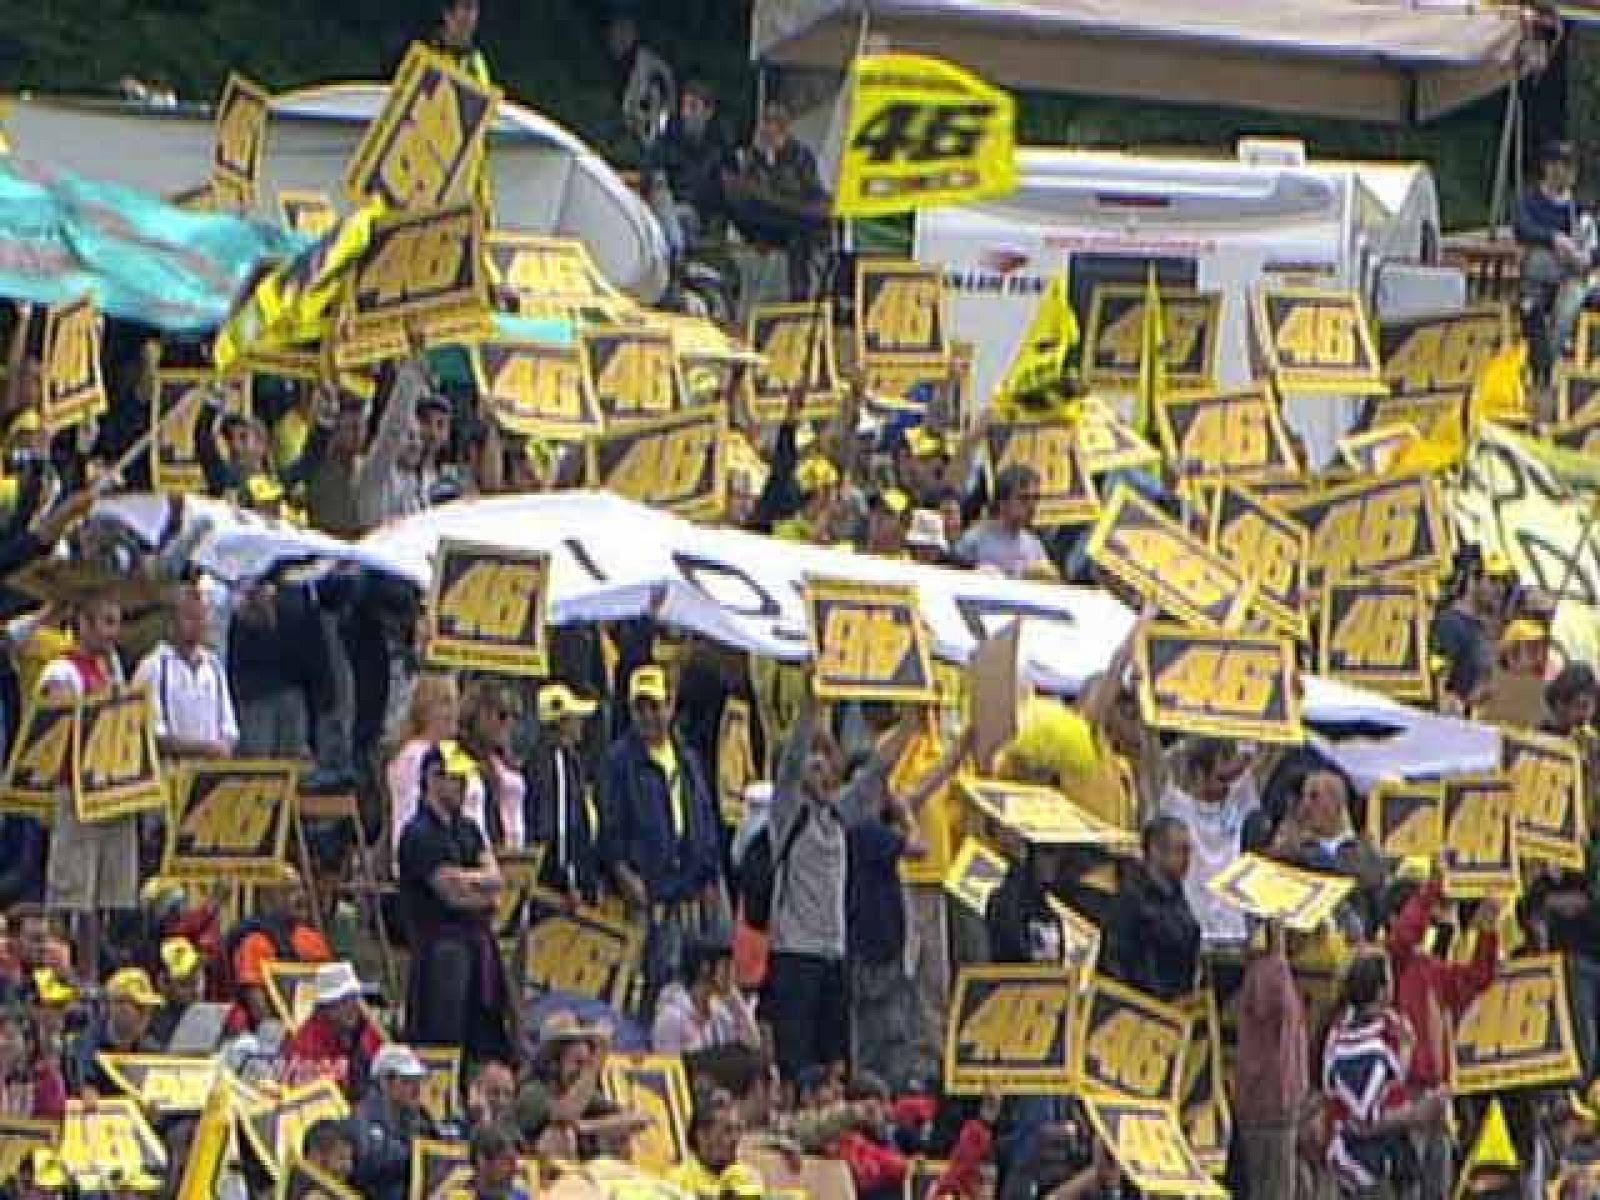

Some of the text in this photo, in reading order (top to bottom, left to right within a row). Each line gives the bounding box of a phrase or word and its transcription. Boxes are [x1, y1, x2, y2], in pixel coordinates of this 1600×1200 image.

[852, 100, 998, 167] 46
[868, 277, 938, 345] 46
[1278, 305, 1360, 364] 46
[493, 352, 580, 414] 46
[598, 342, 676, 410] 46
[1187, 400, 1270, 464] 46
[1310, 488, 1424, 570] 46
[438, 560, 544, 638] 46
[1333, 594, 1414, 666] 46
[1155, 648, 1282, 712] 46
[180, 776, 286, 850] 46
[1446, 790, 1514, 864] 46
[958, 984, 1070, 1062] 46
[1088, 1010, 1186, 1094] 46
[1455, 978, 1560, 1056] 46
